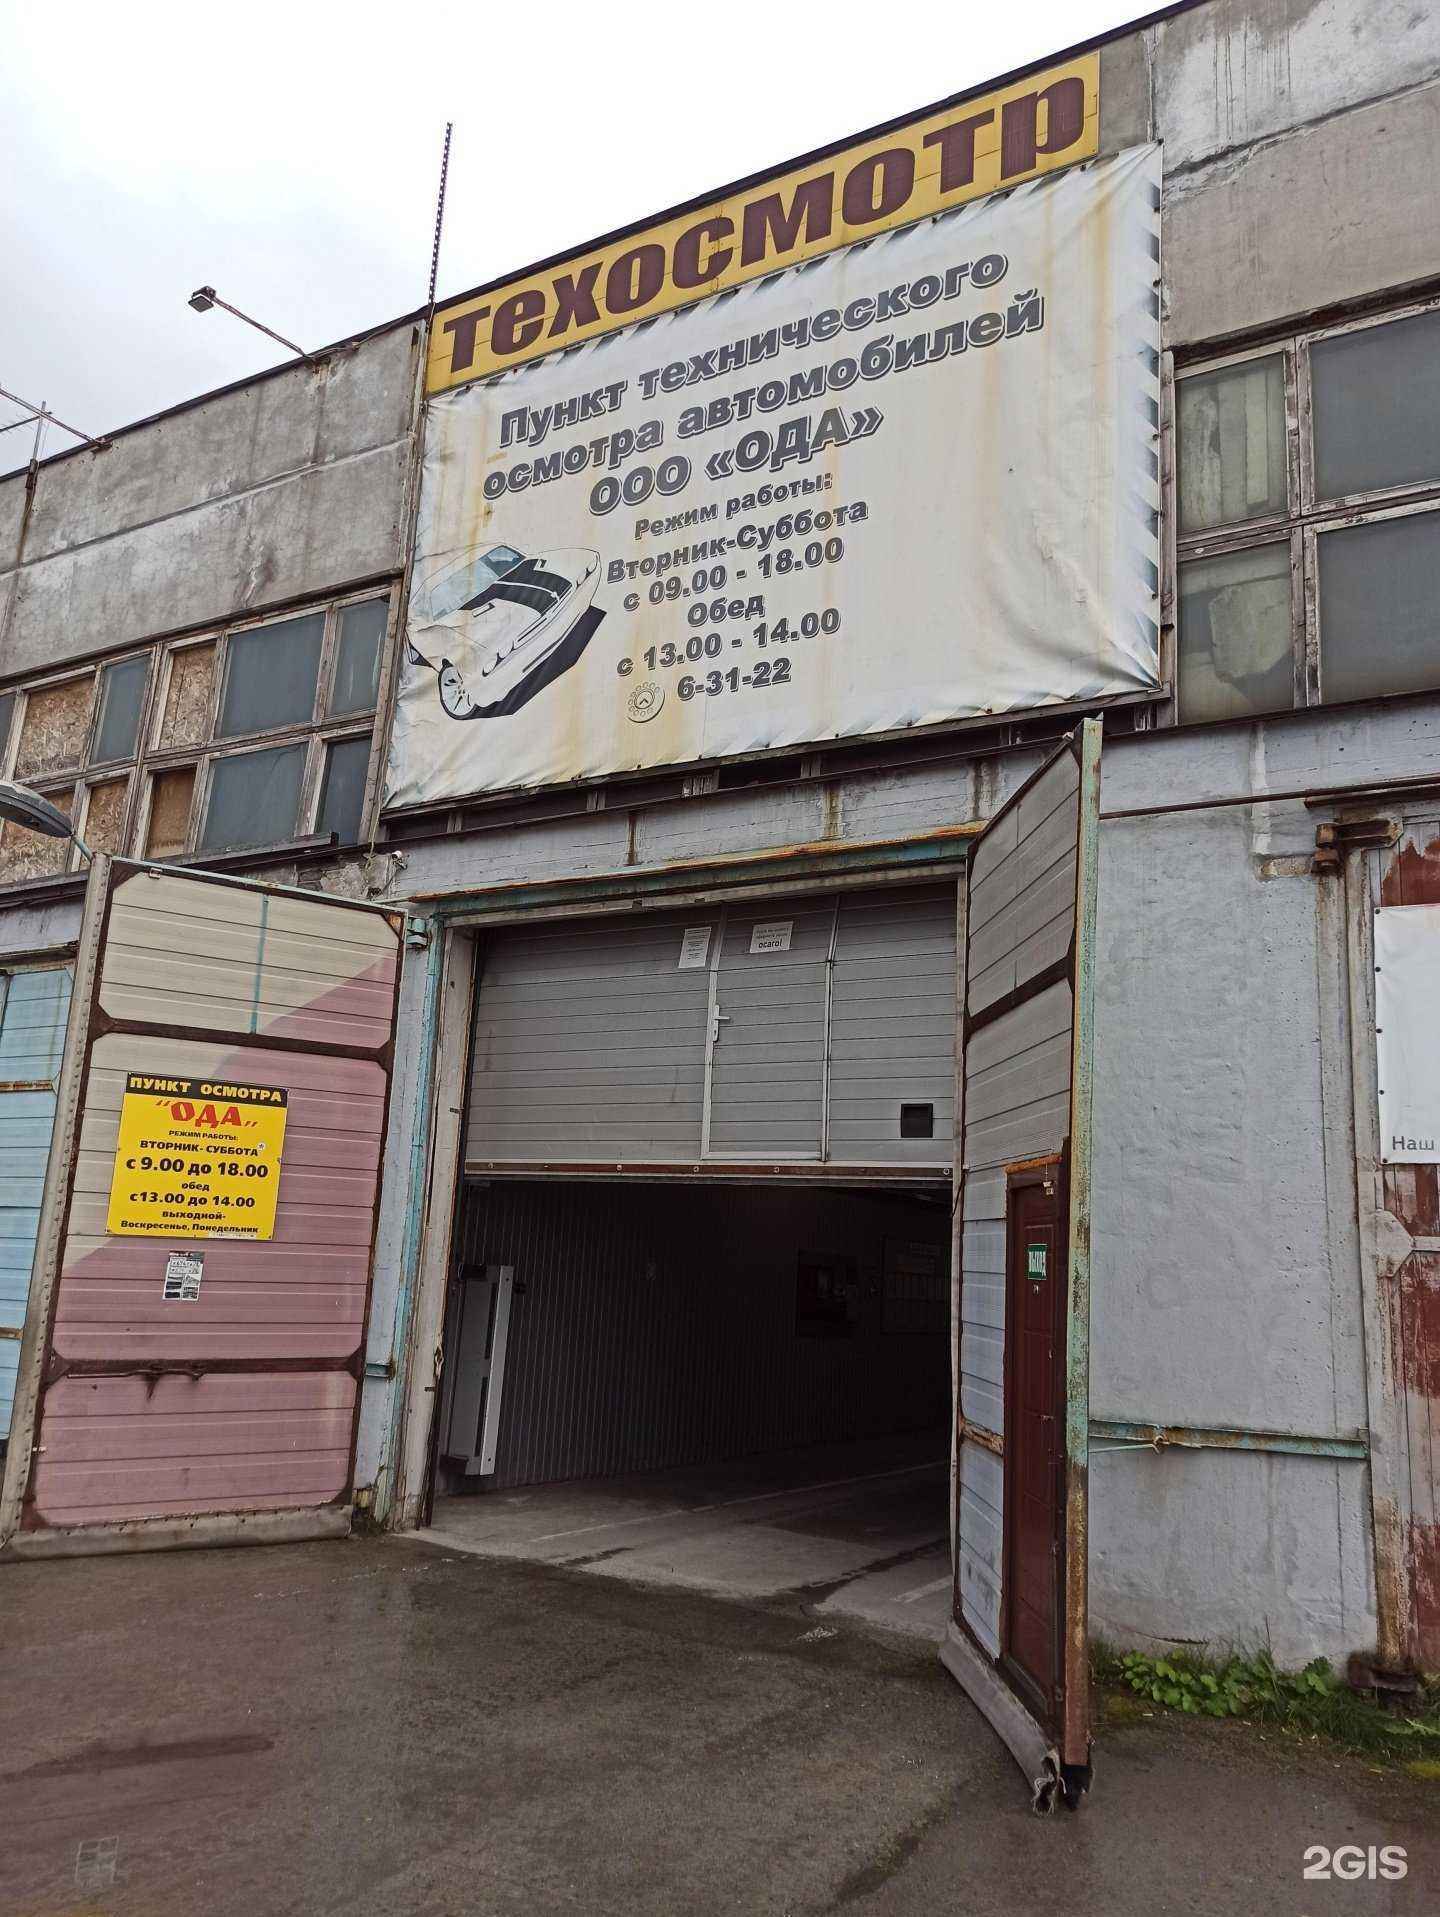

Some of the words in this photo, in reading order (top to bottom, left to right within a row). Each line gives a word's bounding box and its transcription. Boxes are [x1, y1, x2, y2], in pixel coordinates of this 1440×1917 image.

[500, 379, 627, 449] Пункт
[638, 253, 1008, 398] технического
[482, 420, 663, 500] осмотра
[677, 289, 1046, 439] автомобилей
[589, 455, 692, 516] ООО
[704, 405, 885, 480] «ОДА»
[634, 502, 718, 540] Режим
[726, 472, 833, 519] работы:
[606, 500, 869, 584] Вторник-Суббота
[649, 565, 727, 605] 09.00
[758, 537, 844, 578] 18.00
[687, 594, 766, 628] Обед
[644, 632, 722, 671] 13.00
[753, 608, 841, 648] 14.00
[677, 657, 792, 701] 6-31-22
[130, 1077, 191, 1093] ПУНКТ
[200, 1083, 282, 1102] ОСМОТРА
[168, 1129, 201, 1139] РЕЖИМ
[202, 1131, 239, 1141] РАБОТЫ:
[206, 1145, 259, 1157] СУББОТА
[1392, 1135, 1434, 1151] Наш
[126, 1157, 137, 1170] с
[140, 1156, 185, 1173] 9.00
[188, 1162, 212, 1176] до
[217, 1162, 269, 1178] 18.00
[181, 1180, 210, 1192] обед
[187, 1195, 208, 1207] до
[212, 1195, 255, 1208] 14.00
[120, 1220, 190, 1231] Воскресенье,
[192, 1223, 259, 1233] Понедельник
